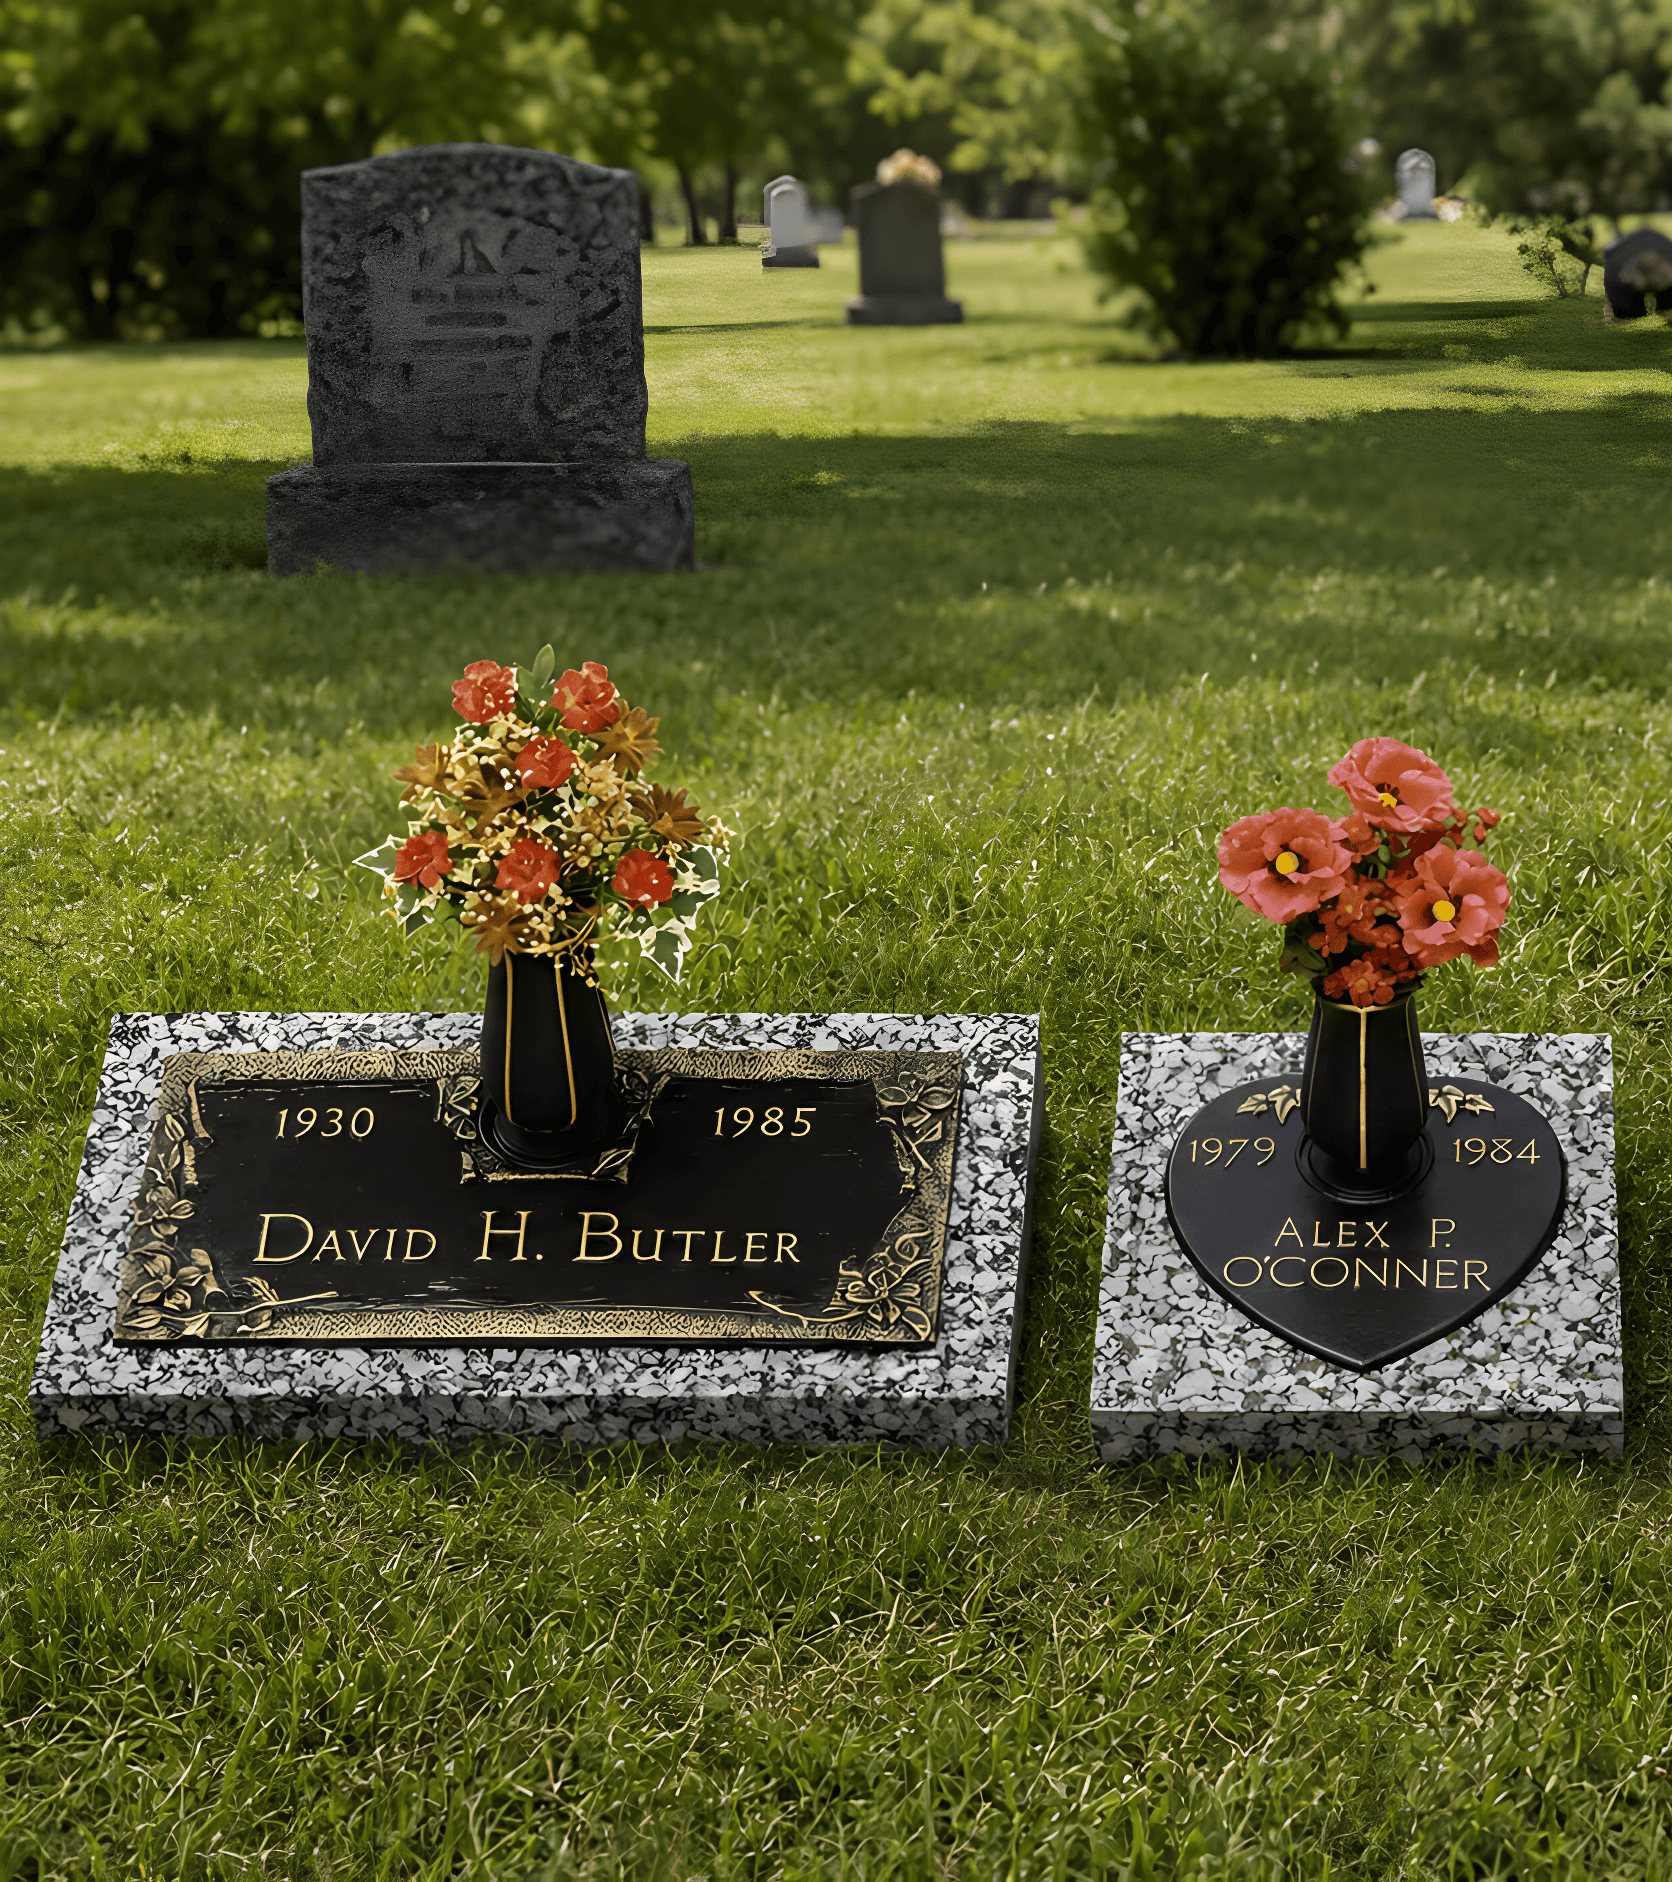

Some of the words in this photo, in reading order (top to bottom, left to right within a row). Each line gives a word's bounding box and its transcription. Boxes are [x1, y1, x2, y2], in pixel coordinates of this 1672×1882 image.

[275, 1106, 375, 1139] 1930
[714, 1106, 818, 1139] 1985
[1189, 1136, 1276, 1168] 1979
[1452, 1136, 1542, 1167] 1984
[252, 1212, 438, 1265] DAVID
[473, 1210, 545, 1263] H.
[571, 1211, 801, 1265] BUTLER
[1274, 1216, 1391, 1249] ALEX
[1430, 1218, 1456, 1249] P.
[1222, 1254, 1492, 1292] O'CONNER
